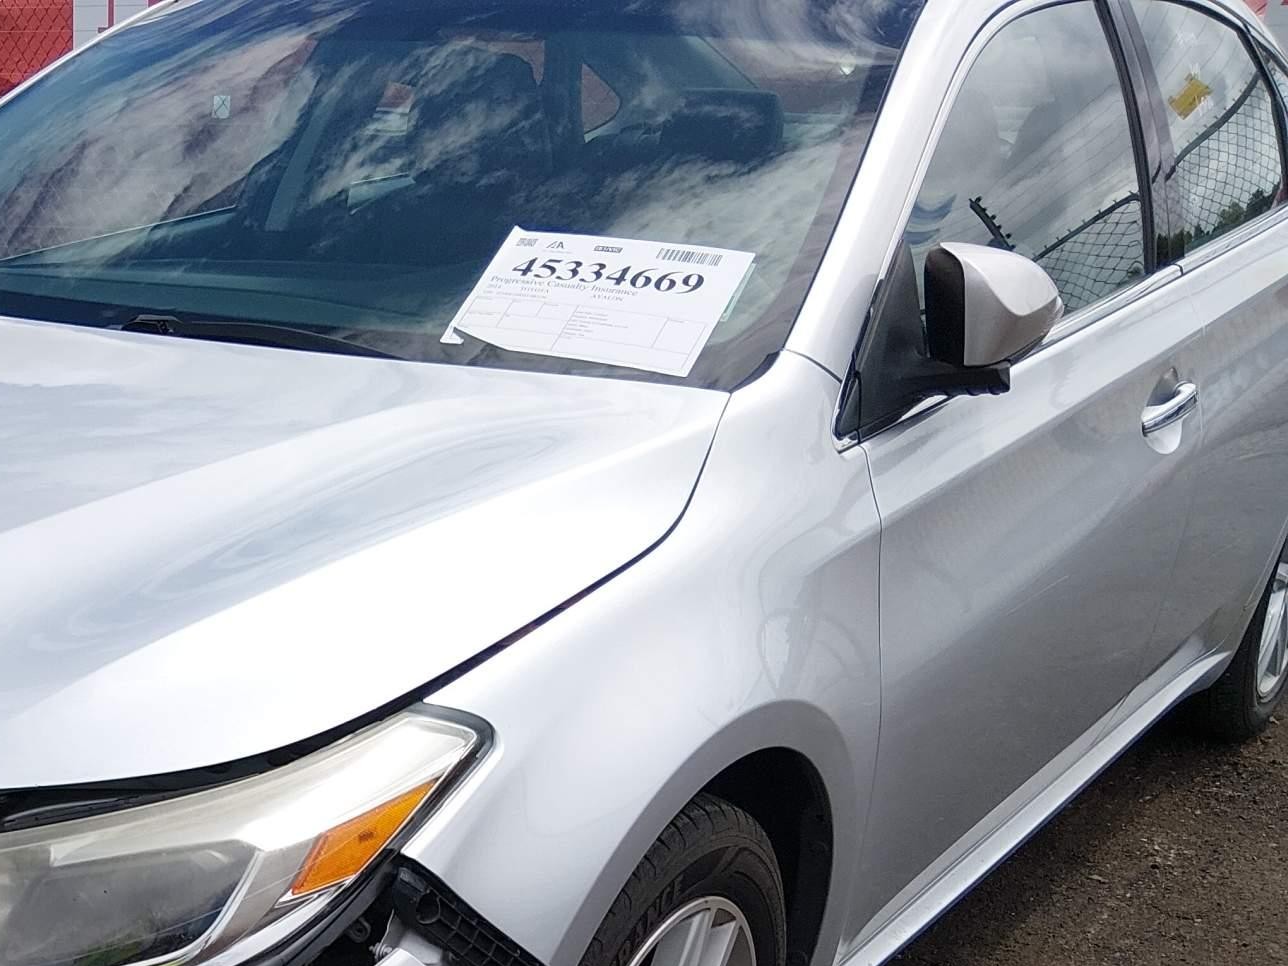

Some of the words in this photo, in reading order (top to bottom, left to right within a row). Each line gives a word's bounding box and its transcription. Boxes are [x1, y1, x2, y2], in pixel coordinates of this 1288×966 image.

[490, 274, 545, 288] Progressive
[546, 279, 588, 291] Casualty
[590, 283, 639, 296] Insurance
[511, 256, 705, 295] 45334669
